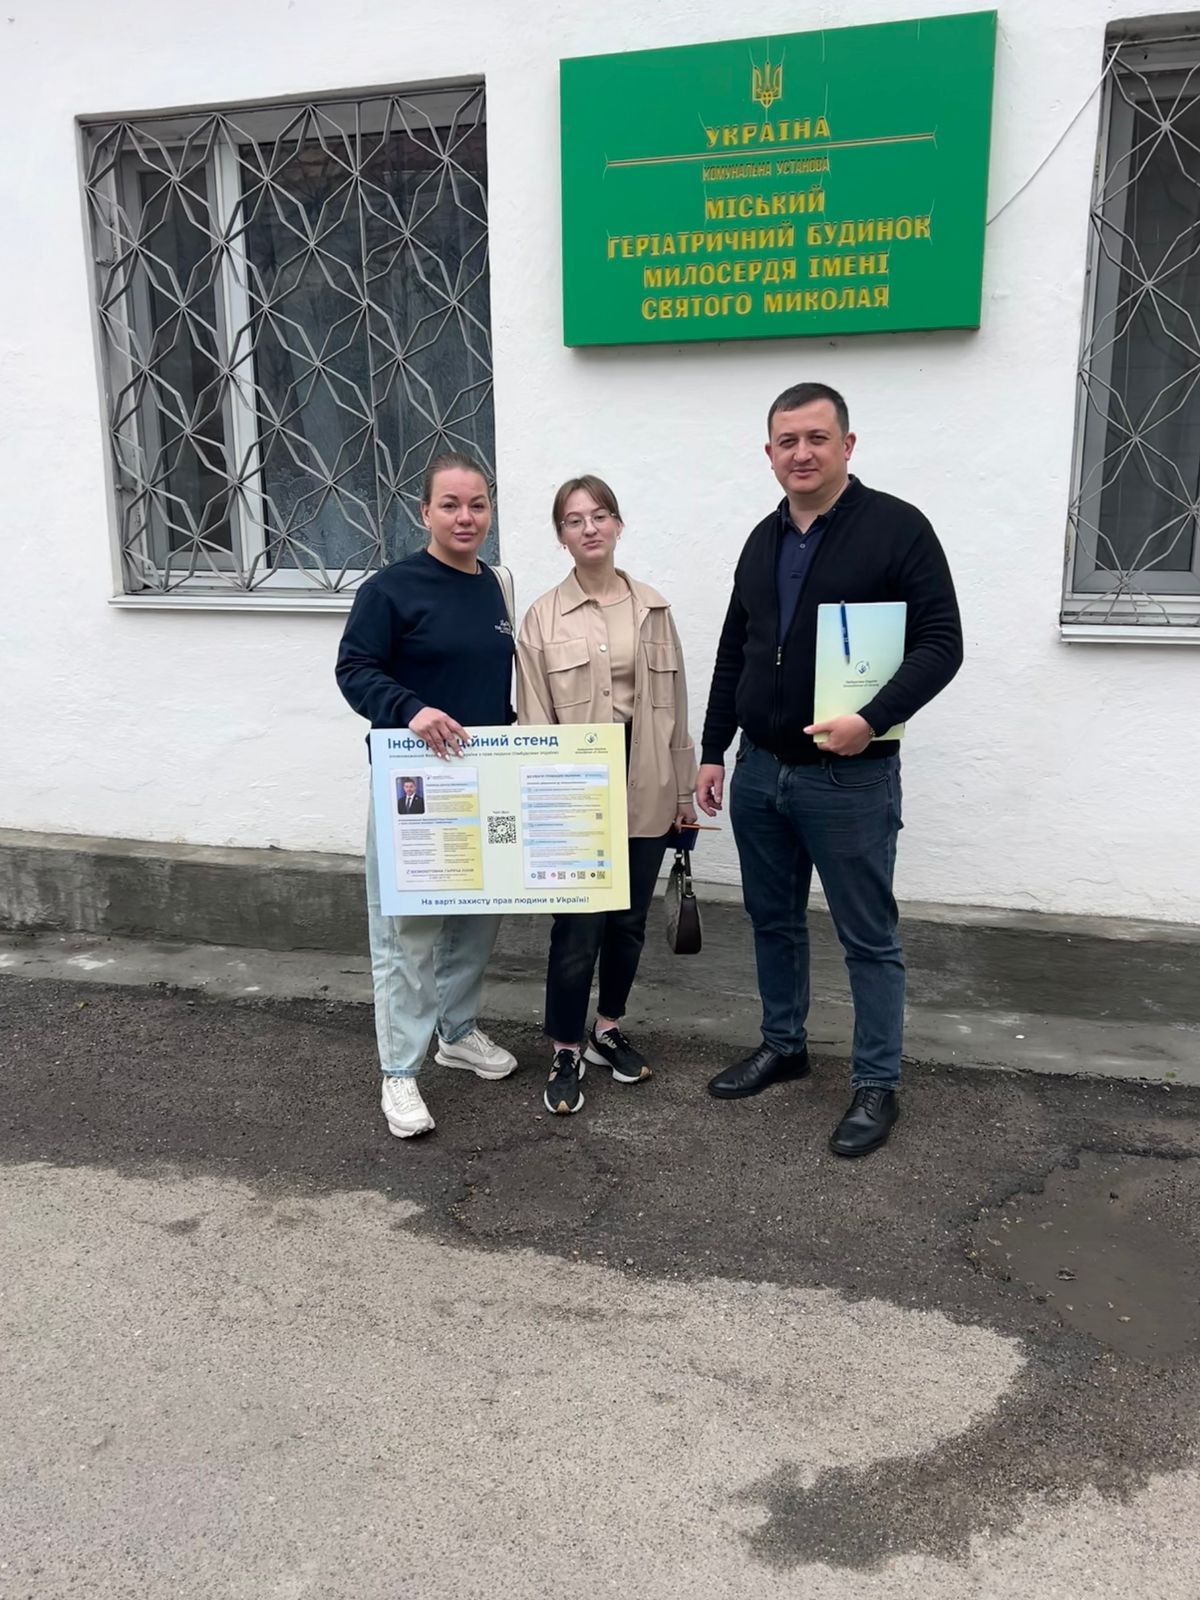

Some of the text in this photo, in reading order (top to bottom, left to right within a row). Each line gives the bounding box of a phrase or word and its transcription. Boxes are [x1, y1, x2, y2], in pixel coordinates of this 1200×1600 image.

[703, 156, 830, 181] КОМУНАЛЬНА УСТАНОВА
[705, 185, 825, 220] МІСЬКИЙ
[607, 215, 931, 259] ГЕРІАТРИЧНИЙ БУДИНОК
[643, 251, 889, 288] МИЛОСЕРДЯ ІМЕНІ
[641, 284, 889, 321] СВЯТОГО МИКОЛАЯ
[513, 735, 559, 747] стенд
[457, 898, 490, 906] захисту
[493, 897, 513, 905] прав
